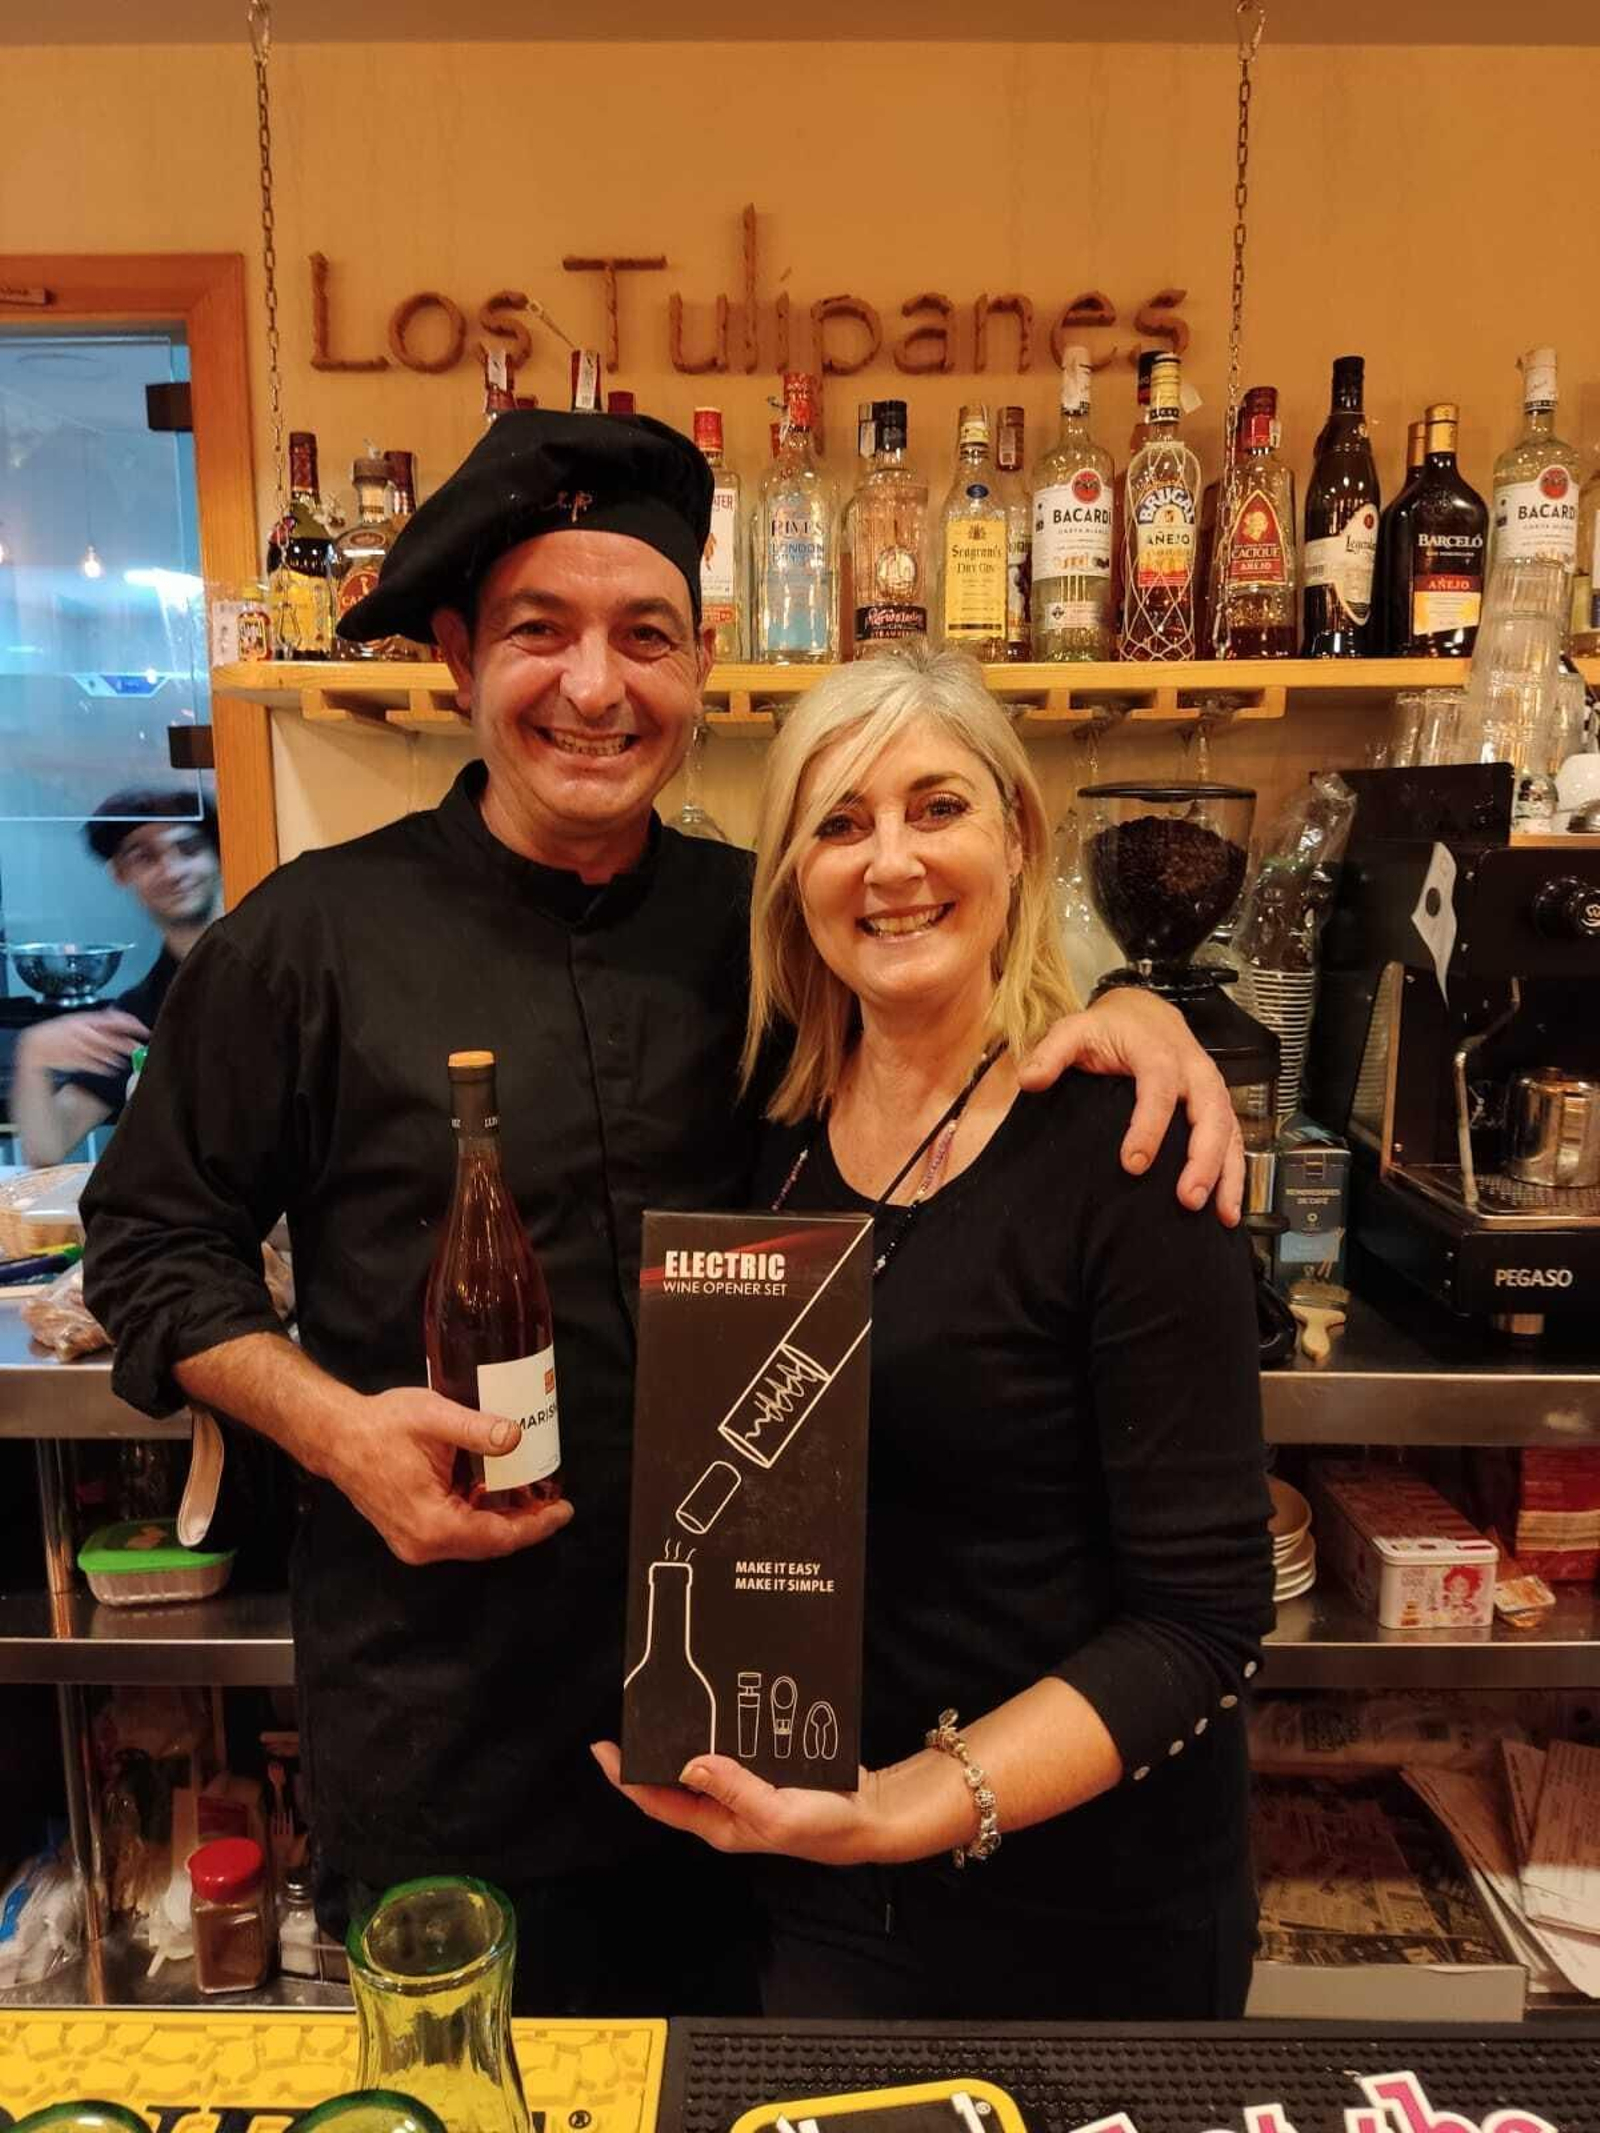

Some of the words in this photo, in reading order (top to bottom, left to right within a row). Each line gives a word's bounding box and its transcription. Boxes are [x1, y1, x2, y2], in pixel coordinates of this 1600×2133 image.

[308, 251, 532, 374] Los
[562, 203, 1192, 376] Tulipanes
[1418, 533, 1484, 549] BARCELÓ
[1429, 576, 1471, 591] AÑEJO
[664, 1250, 786, 1281] ELECTRIC
[1494, 1268, 1574, 1288] PEGASO
[663, 1280, 700, 1294] WINE
[703, 1282, 760, 1295] OPENER
[763, 1283, 788, 1297] SET
[735, 1561, 772, 1575] MAKE
[774, 1561, 788, 1574] IT
[789, 1562, 821, 1576] EASY
[735, 1578, 772, 1591] MAKE
[773, 1578, 787, 1591] IT
[788, 1579, 835, 1592] SIMPLE
